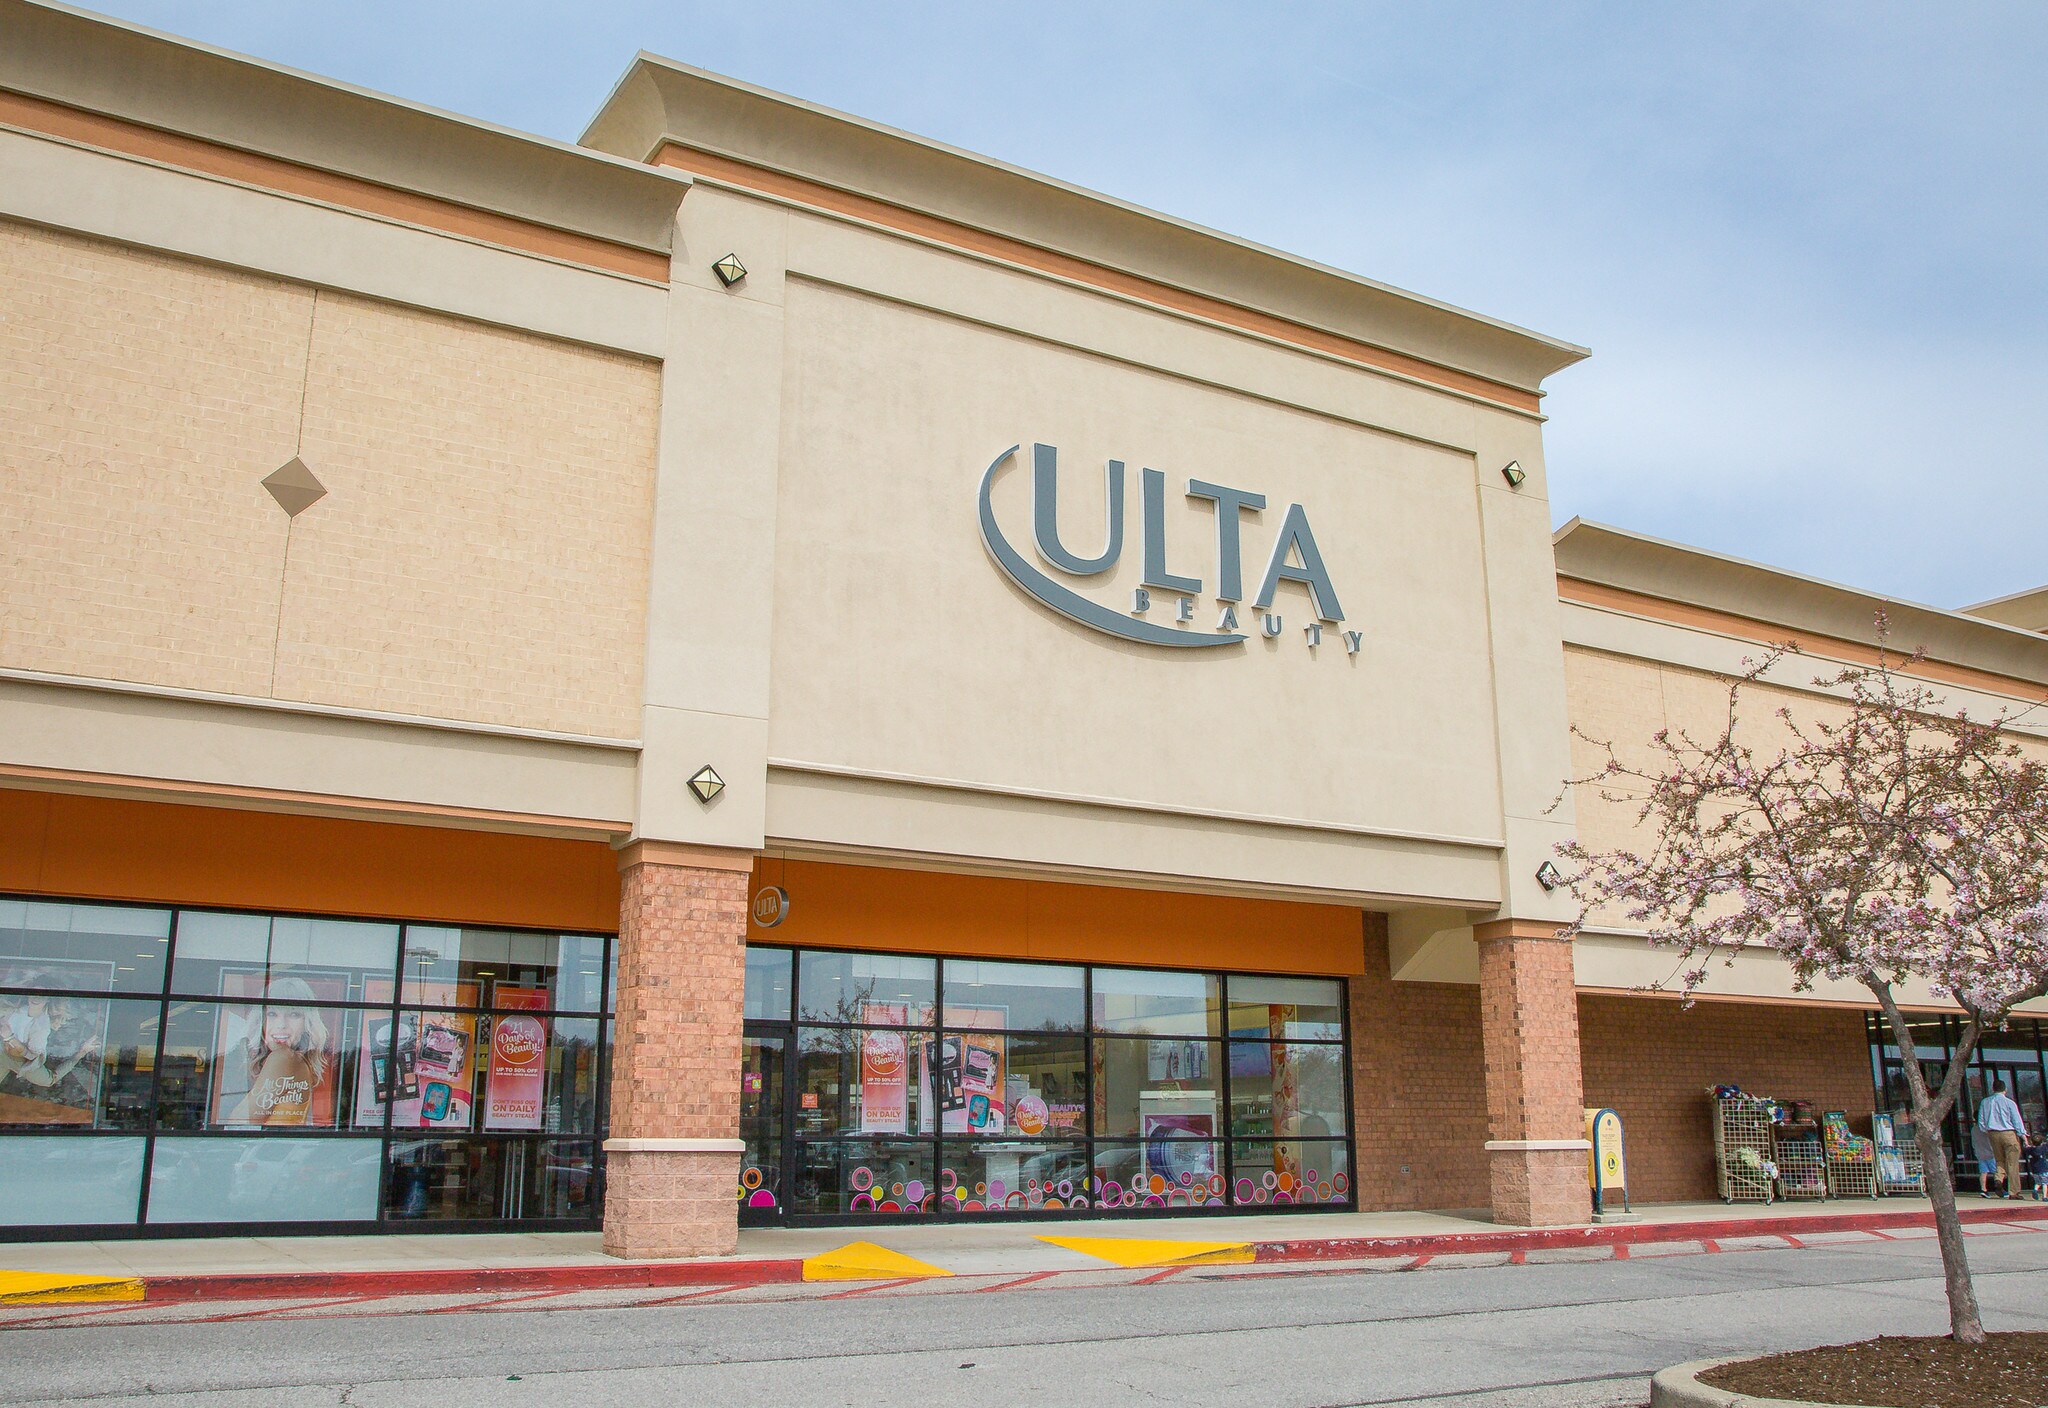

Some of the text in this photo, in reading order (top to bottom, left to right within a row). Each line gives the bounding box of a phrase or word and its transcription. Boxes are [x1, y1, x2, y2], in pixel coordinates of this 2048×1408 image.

[1030, 442, 1345, 622] ULTA
[1131, 588, 1363, 655] BEAUTY
[756, 896, 778, 916] ULTA
[498, 1027, 536, 1045] Days of
[511, 1021, 523, 1034] 21
[503, 1038, 543, 1055] Beauty!
[251, 1075, 309, 1096] All Things
[492, 1104, 536, 1113] ON DAILY
[866, 1110, 902, 1118] ON DAILY
